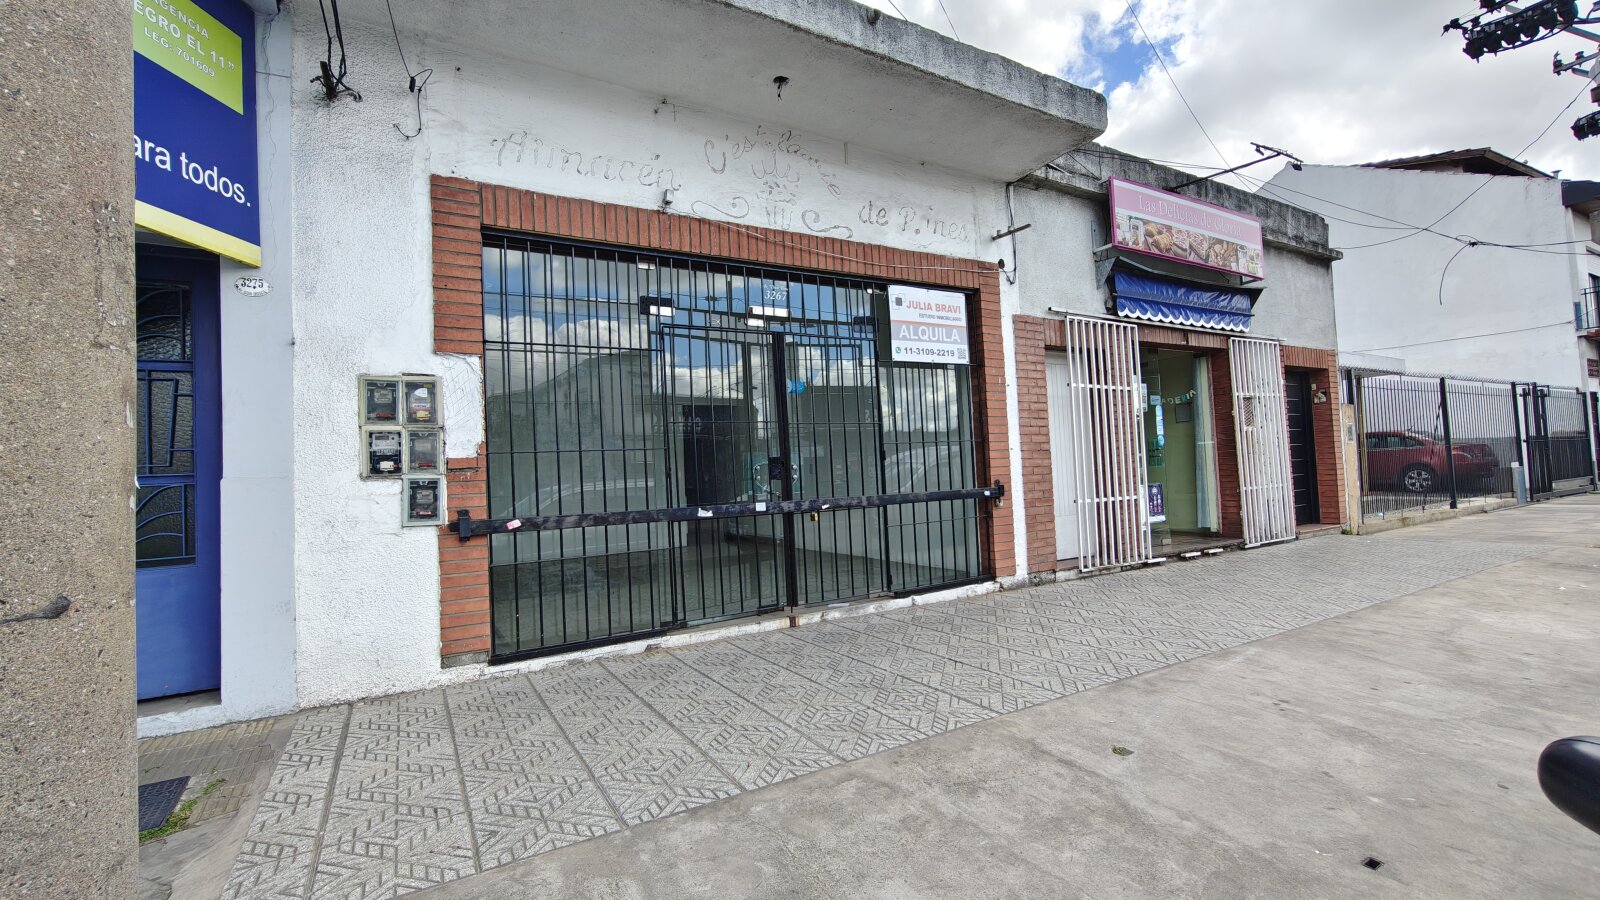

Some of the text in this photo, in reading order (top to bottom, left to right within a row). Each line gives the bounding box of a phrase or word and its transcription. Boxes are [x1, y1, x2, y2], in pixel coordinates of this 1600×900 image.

[186, 33, 205, 56] EL
[176, 47, 215, 77] 701609
[180, 152, 251, 207] todos.
[858, 200, 889, 227] de
[1139, 195, 1242, 237] Las Delicias de Gloria
[240, 277, 264, 289] 3275
[764, 290, 787, 301] 3267
[906, 300, 962, 315] JULIA BRAVI
[899, 325, 961, 342] ALQUILA
[903, 346, 955, 357] 11-3109-2219
